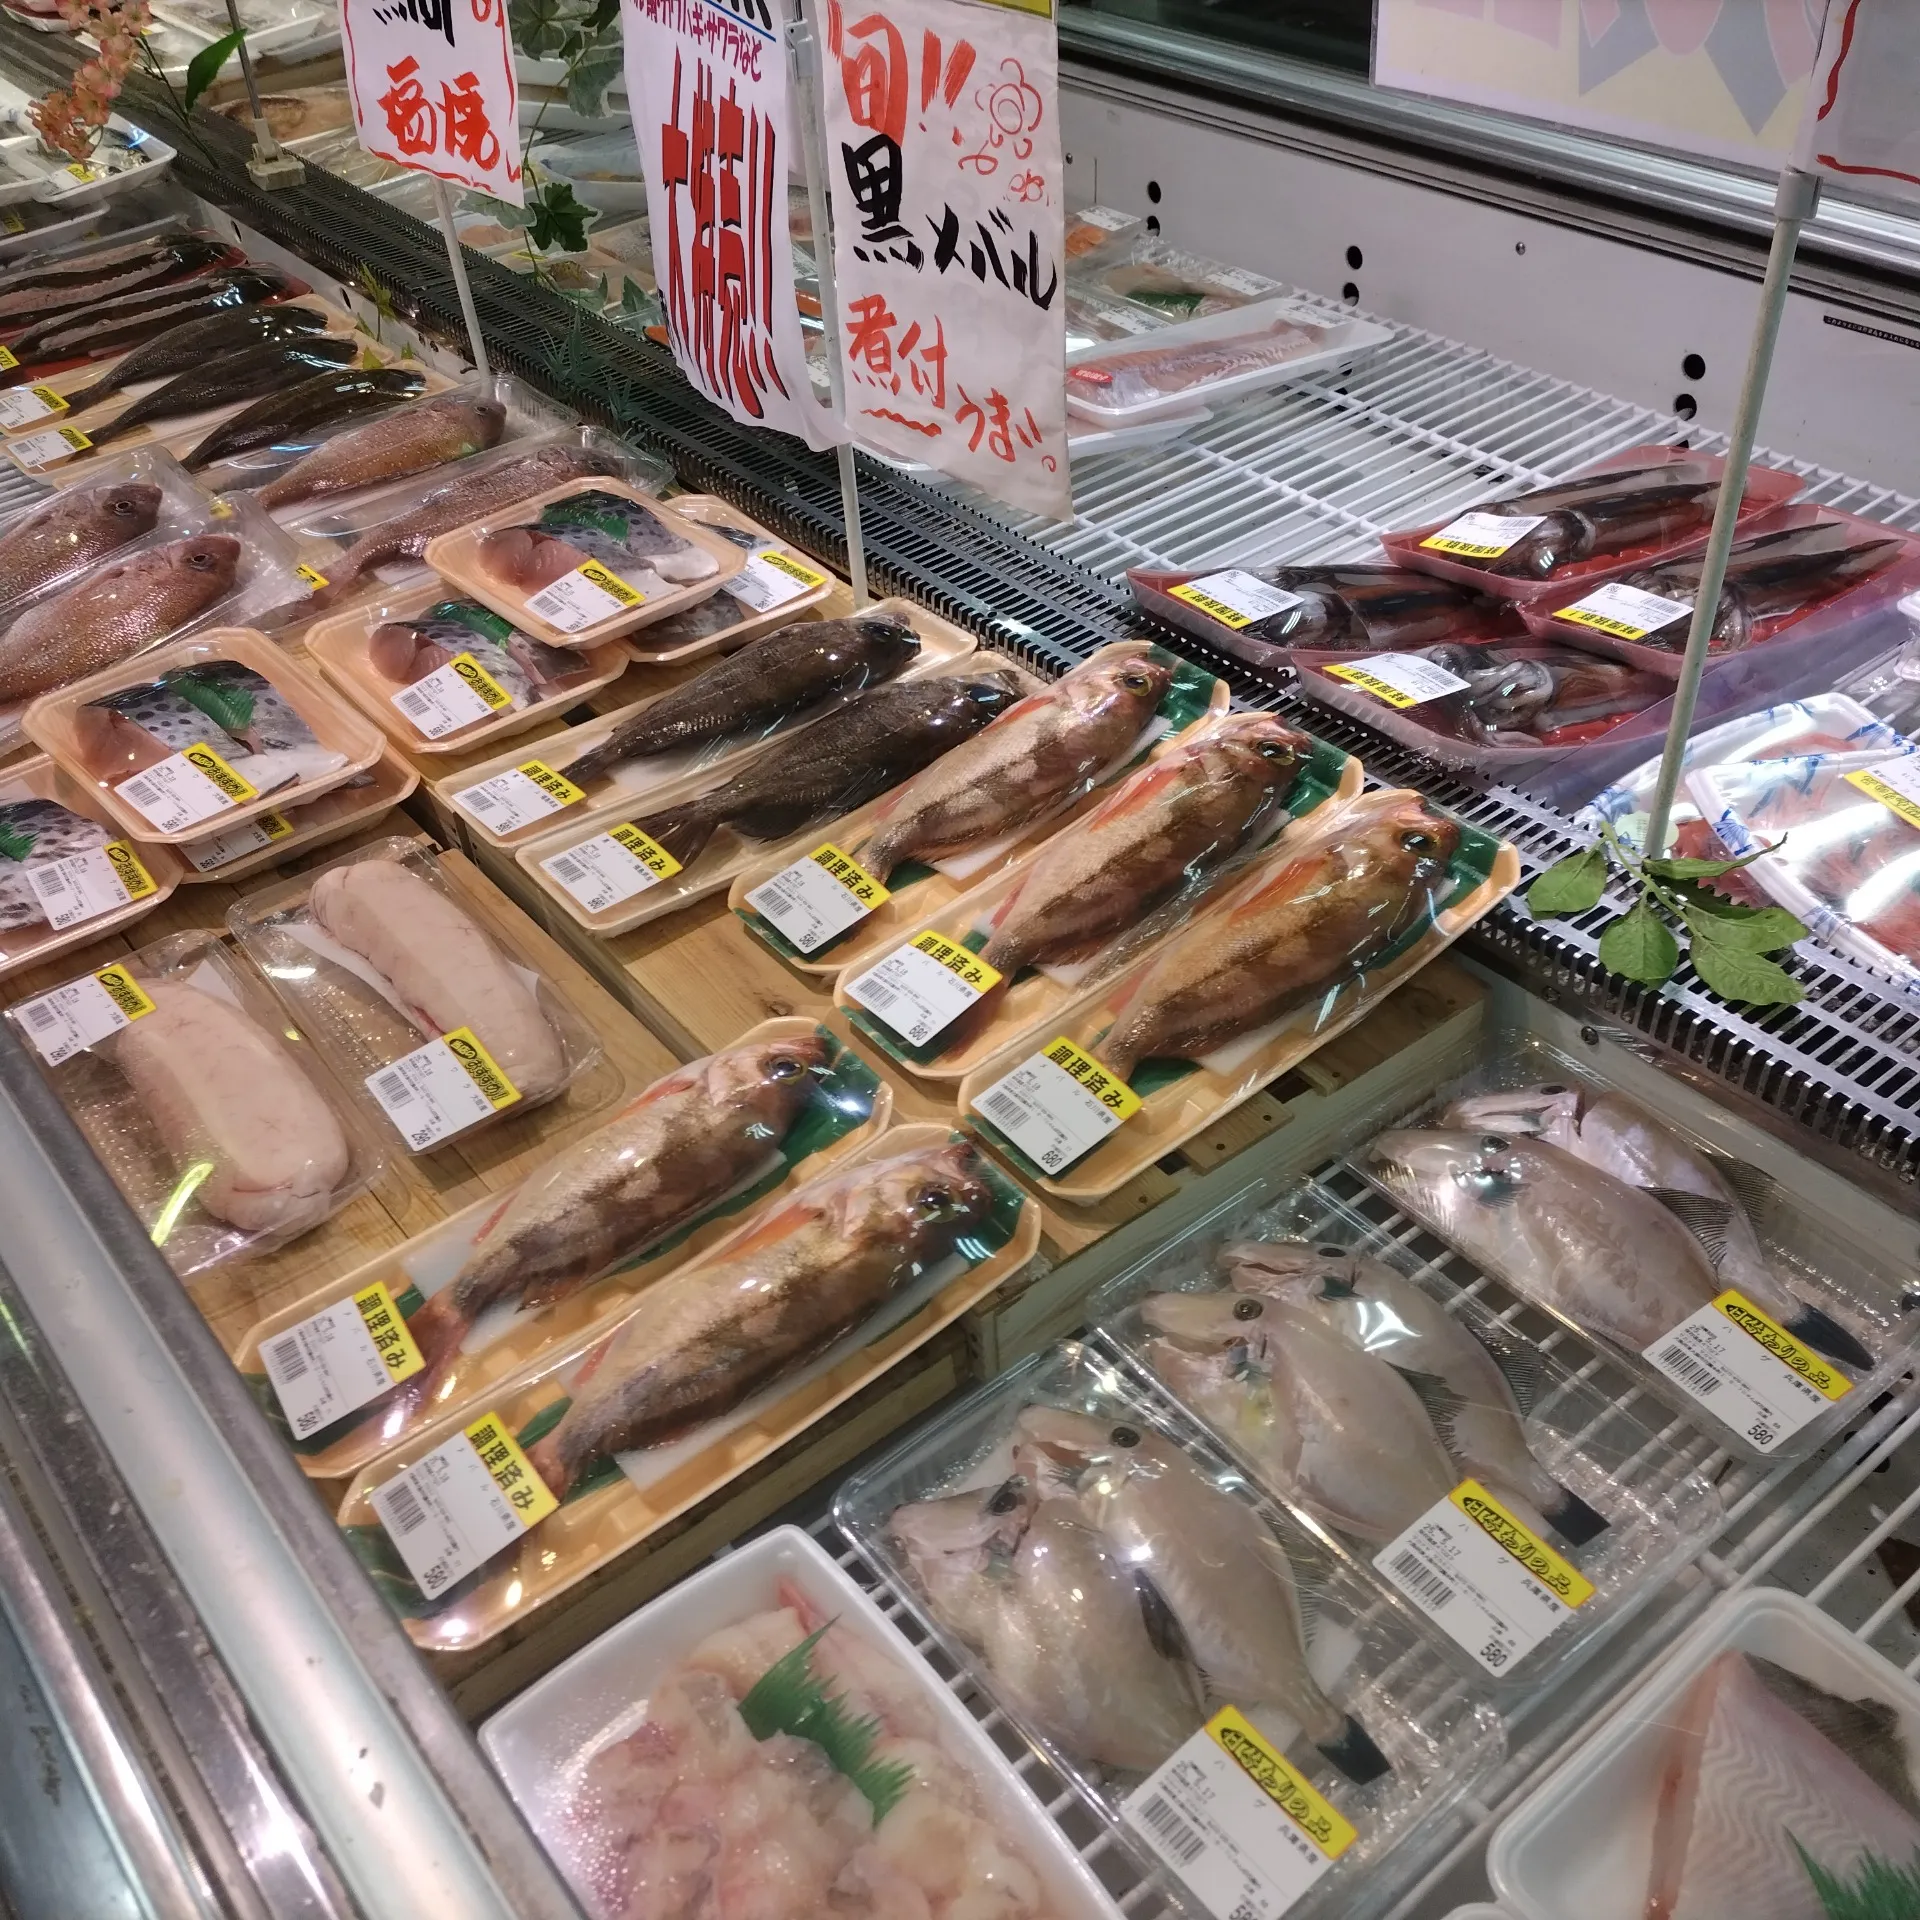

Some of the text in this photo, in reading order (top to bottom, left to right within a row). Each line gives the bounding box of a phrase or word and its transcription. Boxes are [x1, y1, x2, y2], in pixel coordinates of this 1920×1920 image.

[842, 133, 1058, 310] 黒メバル
[847, 294, 948, 408] 煮付
[1182, 591, 1246, 622] 鮮度抜群！
[1568, 612, 1640, 634] 鮮度抜群！
[1338, 669, 1410, 702] 鮮度抜群！
[521, 765, 571, 799] 調理済み
[612, 829, 666, 871] 調理済み
[814, 850, 874, 899] 調理済み
[587, 897, 605, 909] 980
[841, 892, 863, 912] 石川県産
[55, 913, 71, 926] 580
[799, 933, 817, 948] 580
[915, 937, 983, 983] 調理済み
[948, 977, 973, 998] 石川県産
[908, 1025, 928, 1041] 680
[50, 1047, 68, 1061] 298
[437, 1050, 488, 1112] サワラ 大阪産
[1047, 1045, 1124, 1108] 調理済み
[1039, 1062, 1081, 1097] メバル
[1085, 1100, 1112, 1124] 石川県産
[411, 1129, 431, 1145] 298
[1041, 1150, 1063, 1167] 680
[356, 1292, 406, 1368] 調理済み
[1727, 1306, 1830, 1389] 日替わりの品
[368, 1358, 386, 1386] 石川県産
[1784, 1374, 1821, 1403] 兵庫県産
[297, 1411, 319, 1431] 580
[1747, 1424, 1773, 1445] 580
[468, 1424, 534, 1509] 調理済み
[491, 1499, 516, 1531] 石川県産
[1464, 1498, 1571, 1595] 日替わりの品
[424, 1565, 448, 1590] 580
[1522, 1579, 1560, 1612] 兵庫県産
[1480, 1643, 1507, 1667] 580
[1280, 1825, 1318, 1864] 兵庫県産
